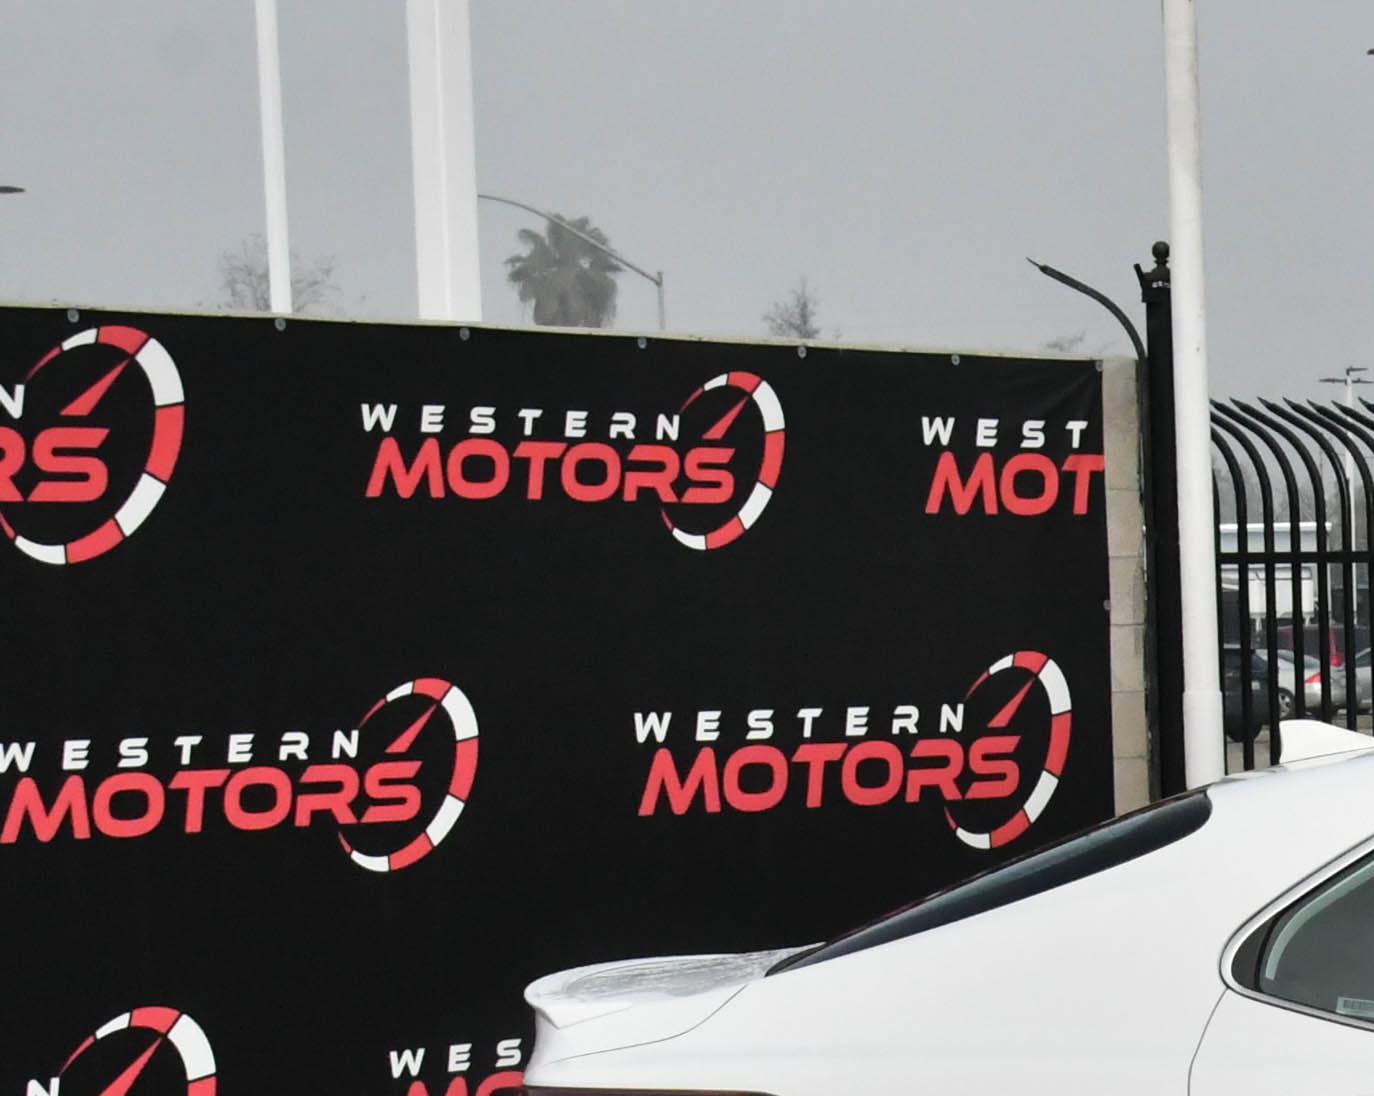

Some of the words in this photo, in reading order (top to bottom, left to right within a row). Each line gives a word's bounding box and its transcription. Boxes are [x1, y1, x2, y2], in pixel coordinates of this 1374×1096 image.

[361, 403, 680, 441] WESTERN
[921, 416, 1089, 449] WEST
[365, 436, 735, 504] MOTORS
[925, 447, 1105, 516] MOT
[0, 729, 360, 774] WESTERN
[633, 703, 965, 744] WESTERN
[0, 760, 422, 844] MOTORS
[638, 735, 1021, 817] MOTORS
